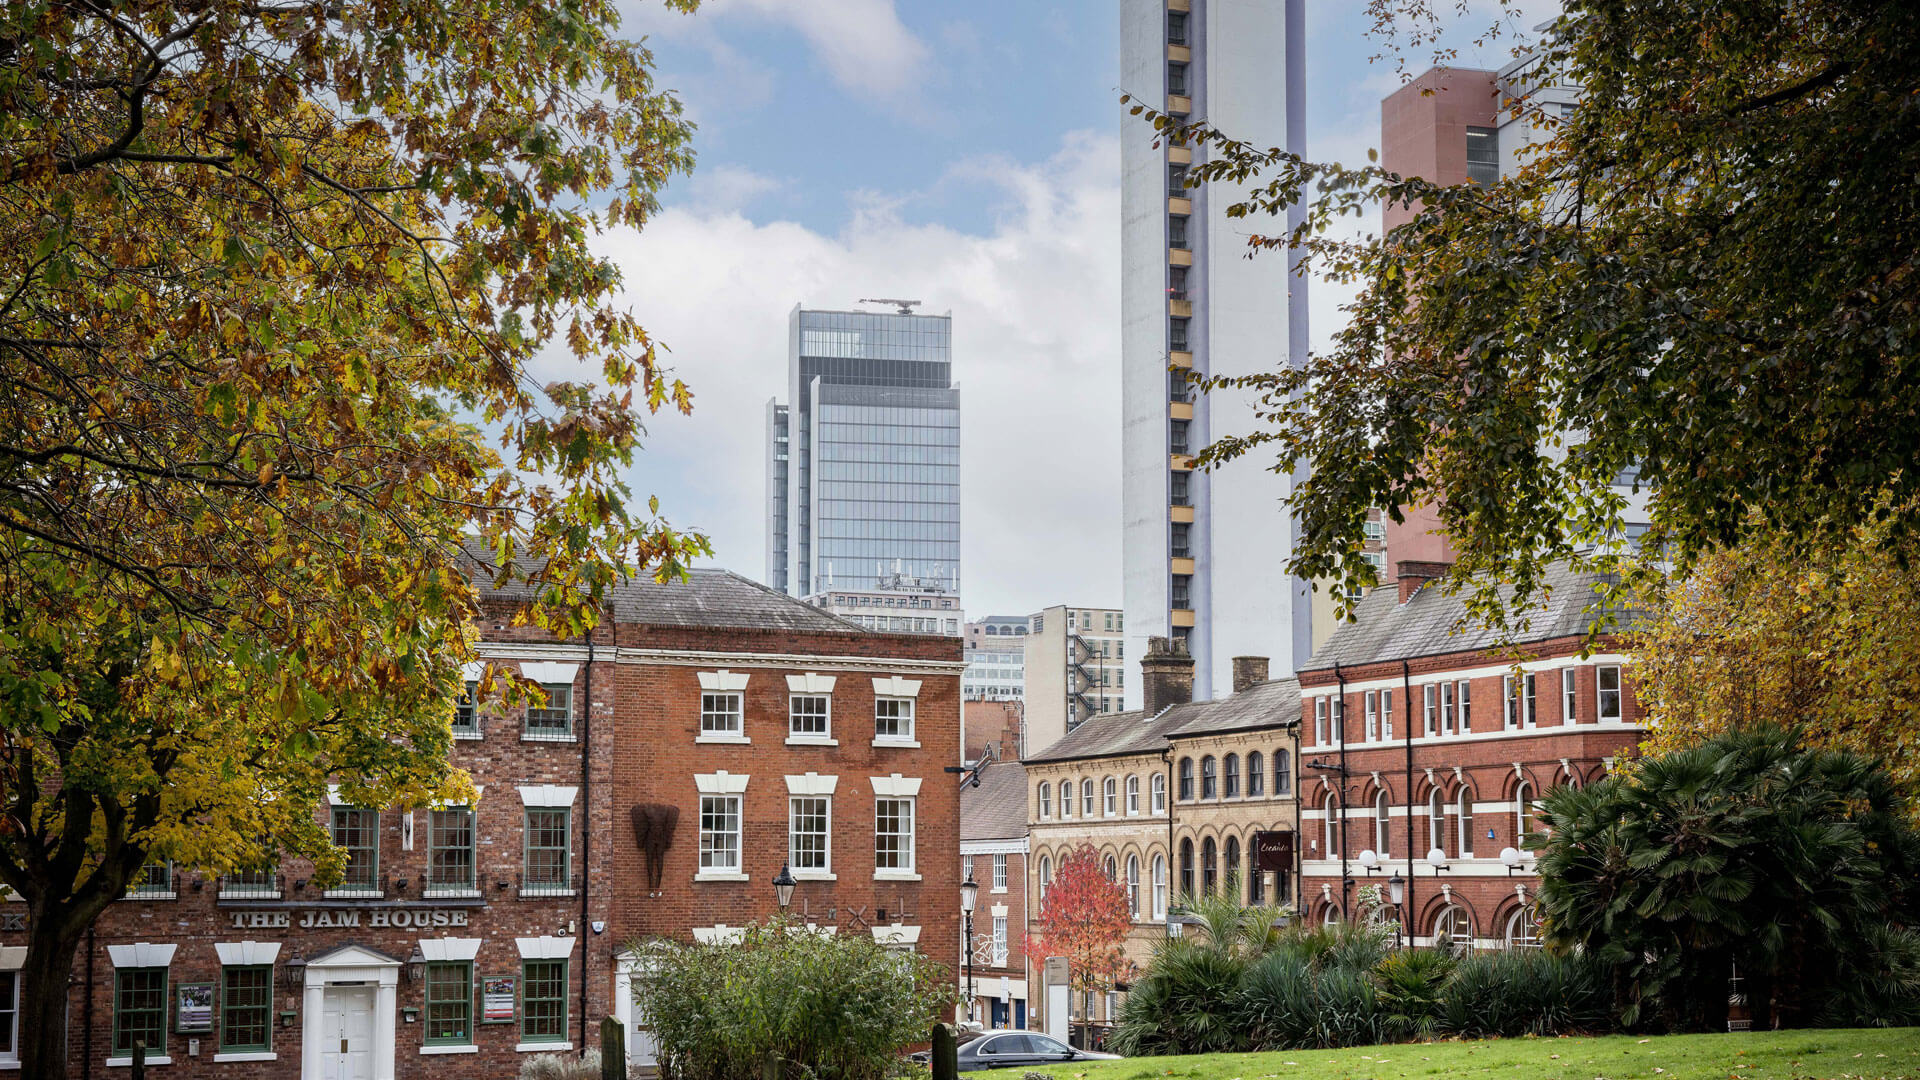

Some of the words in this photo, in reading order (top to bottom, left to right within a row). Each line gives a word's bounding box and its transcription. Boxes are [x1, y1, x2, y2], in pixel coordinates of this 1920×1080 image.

[229, 911, 290, 928] THE
[300, 911, 361, 928] JAM
[368, 910, 468, 927] HOUSE
